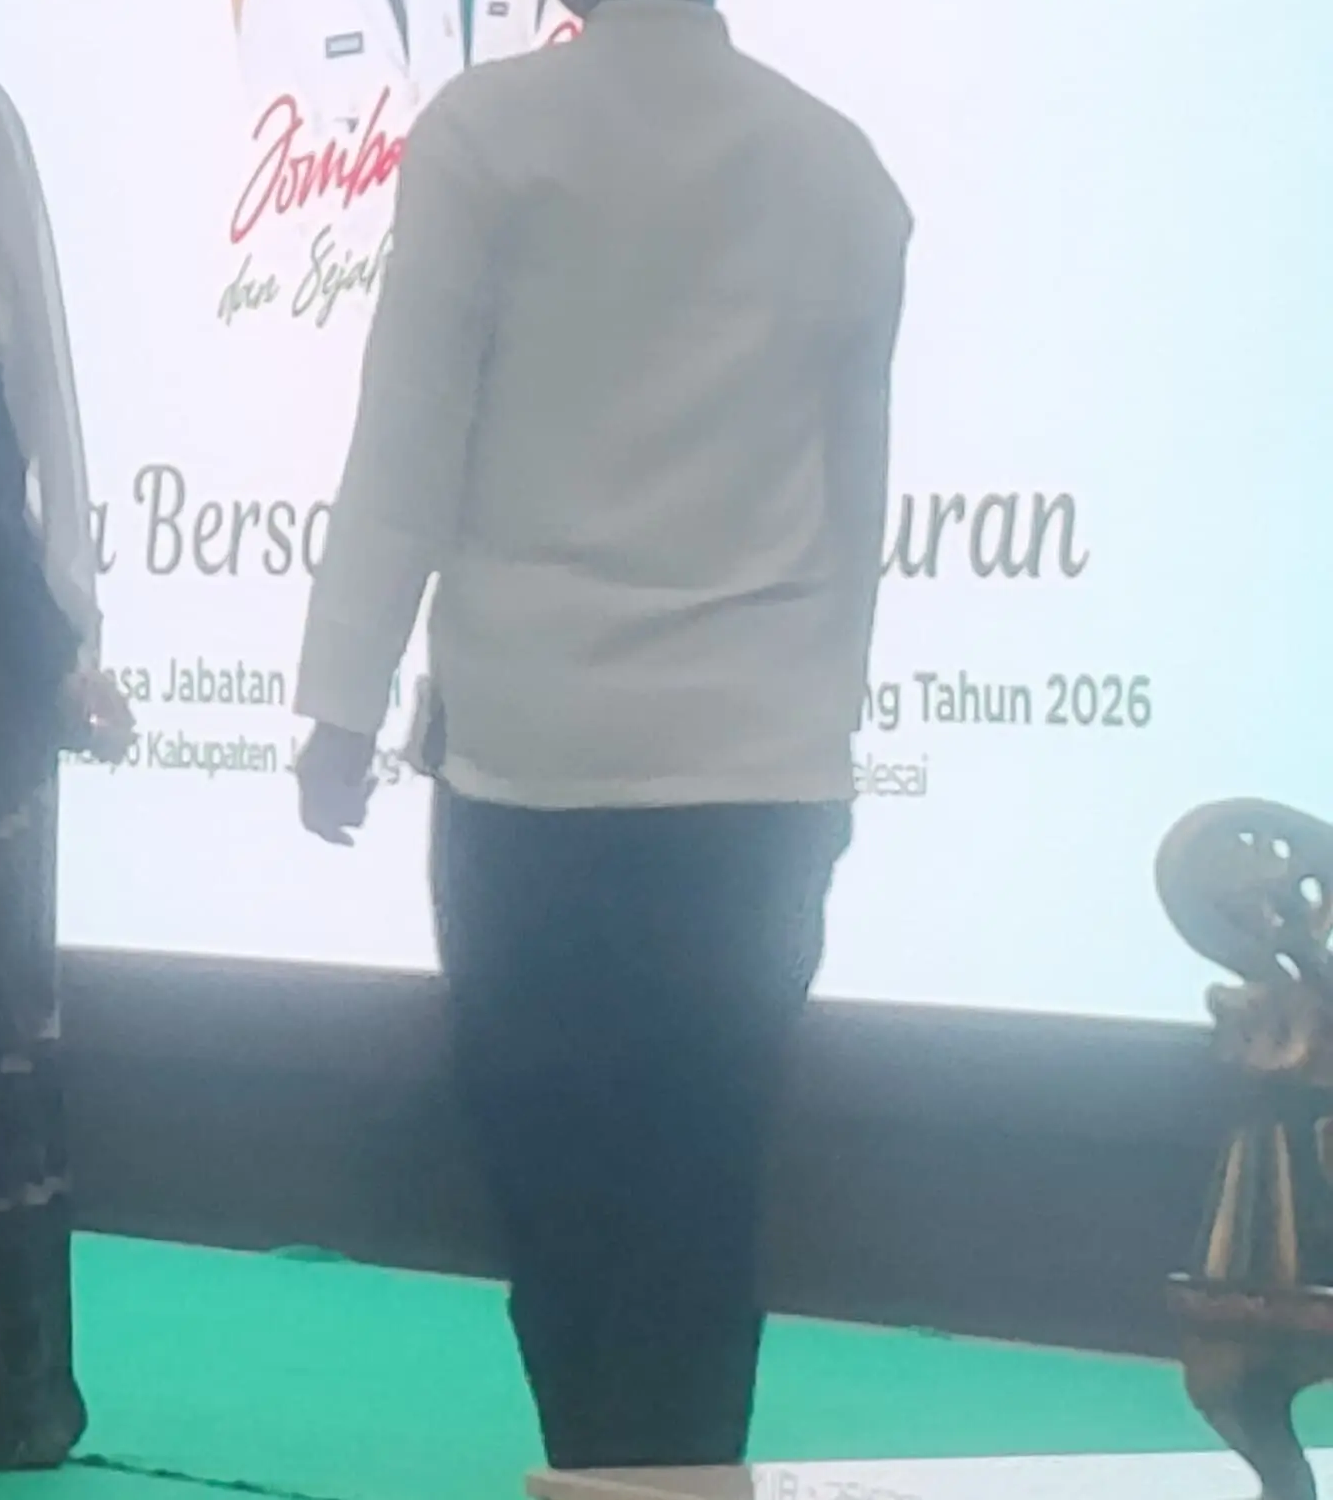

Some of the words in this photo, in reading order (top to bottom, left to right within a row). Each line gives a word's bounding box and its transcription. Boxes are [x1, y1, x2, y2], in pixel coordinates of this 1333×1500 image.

[161, 656, 286, 706] Jabatan
[912, 669, 1033, 726] Tahun
[1044, 673, 1153, 728] 2026
[146, 729, 278, 780] Kabupaten
